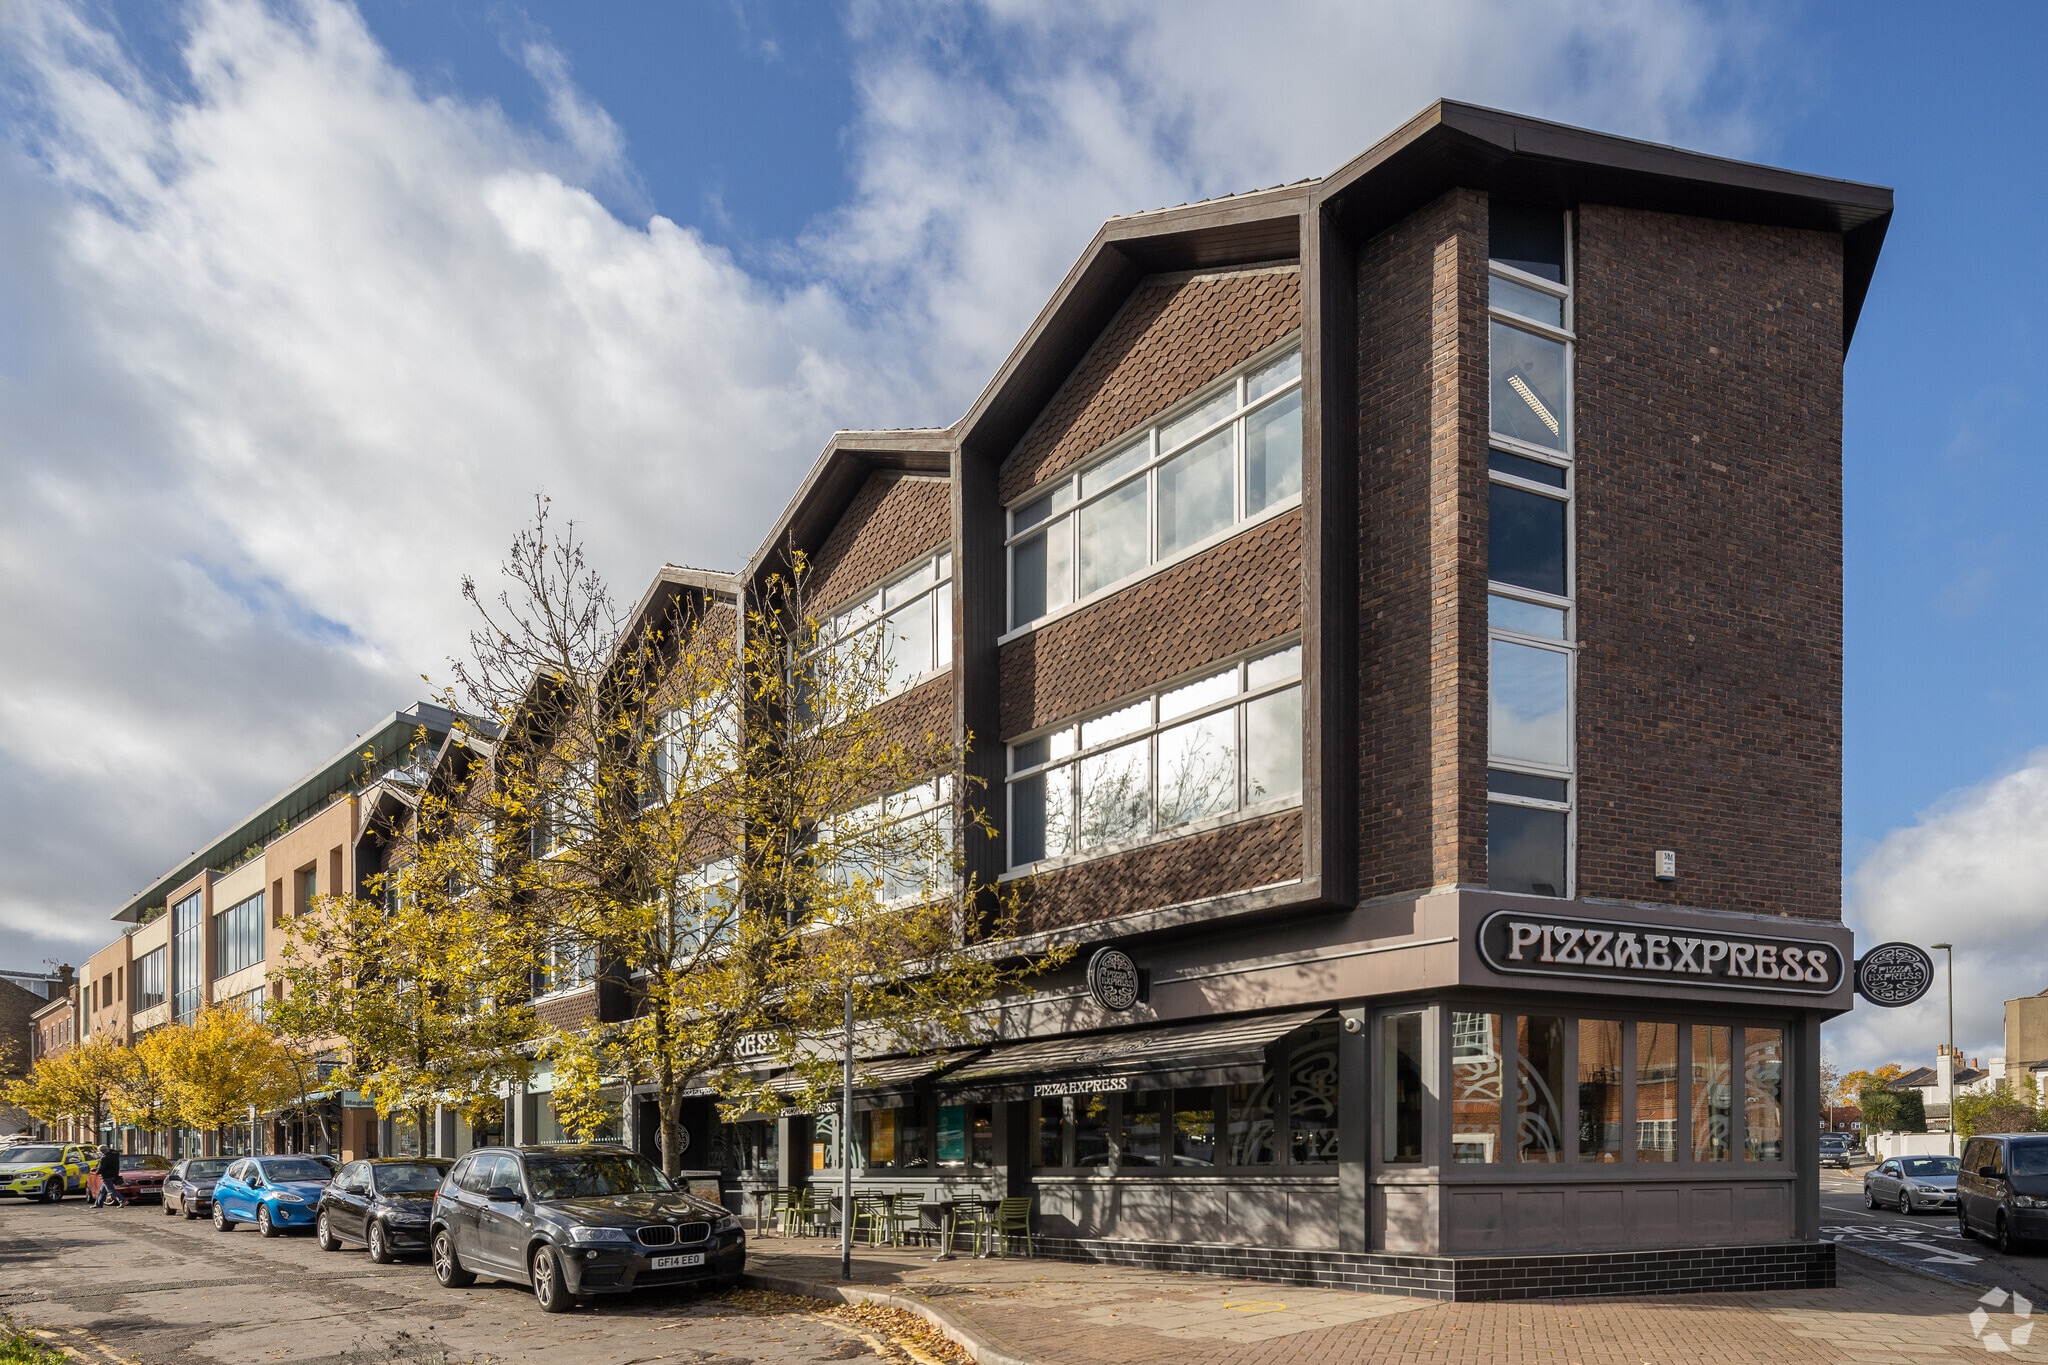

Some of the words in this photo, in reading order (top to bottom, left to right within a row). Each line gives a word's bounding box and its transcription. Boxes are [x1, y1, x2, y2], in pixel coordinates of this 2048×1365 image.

[1508, 921, 1830, 984] PIZZAEXPRESS
[1878, 965, 1912, 974] PIZZA
[1107, 970, 1128, 980] PIZZA
[1868, 971, 1922, 981] EXPRESS
[1101, 976, 1134, 988] EXPRESS
[1033, 1077, 1128, 1097] PIZZAEXPRESS
[657, 1257, 680, 1267] GF14
